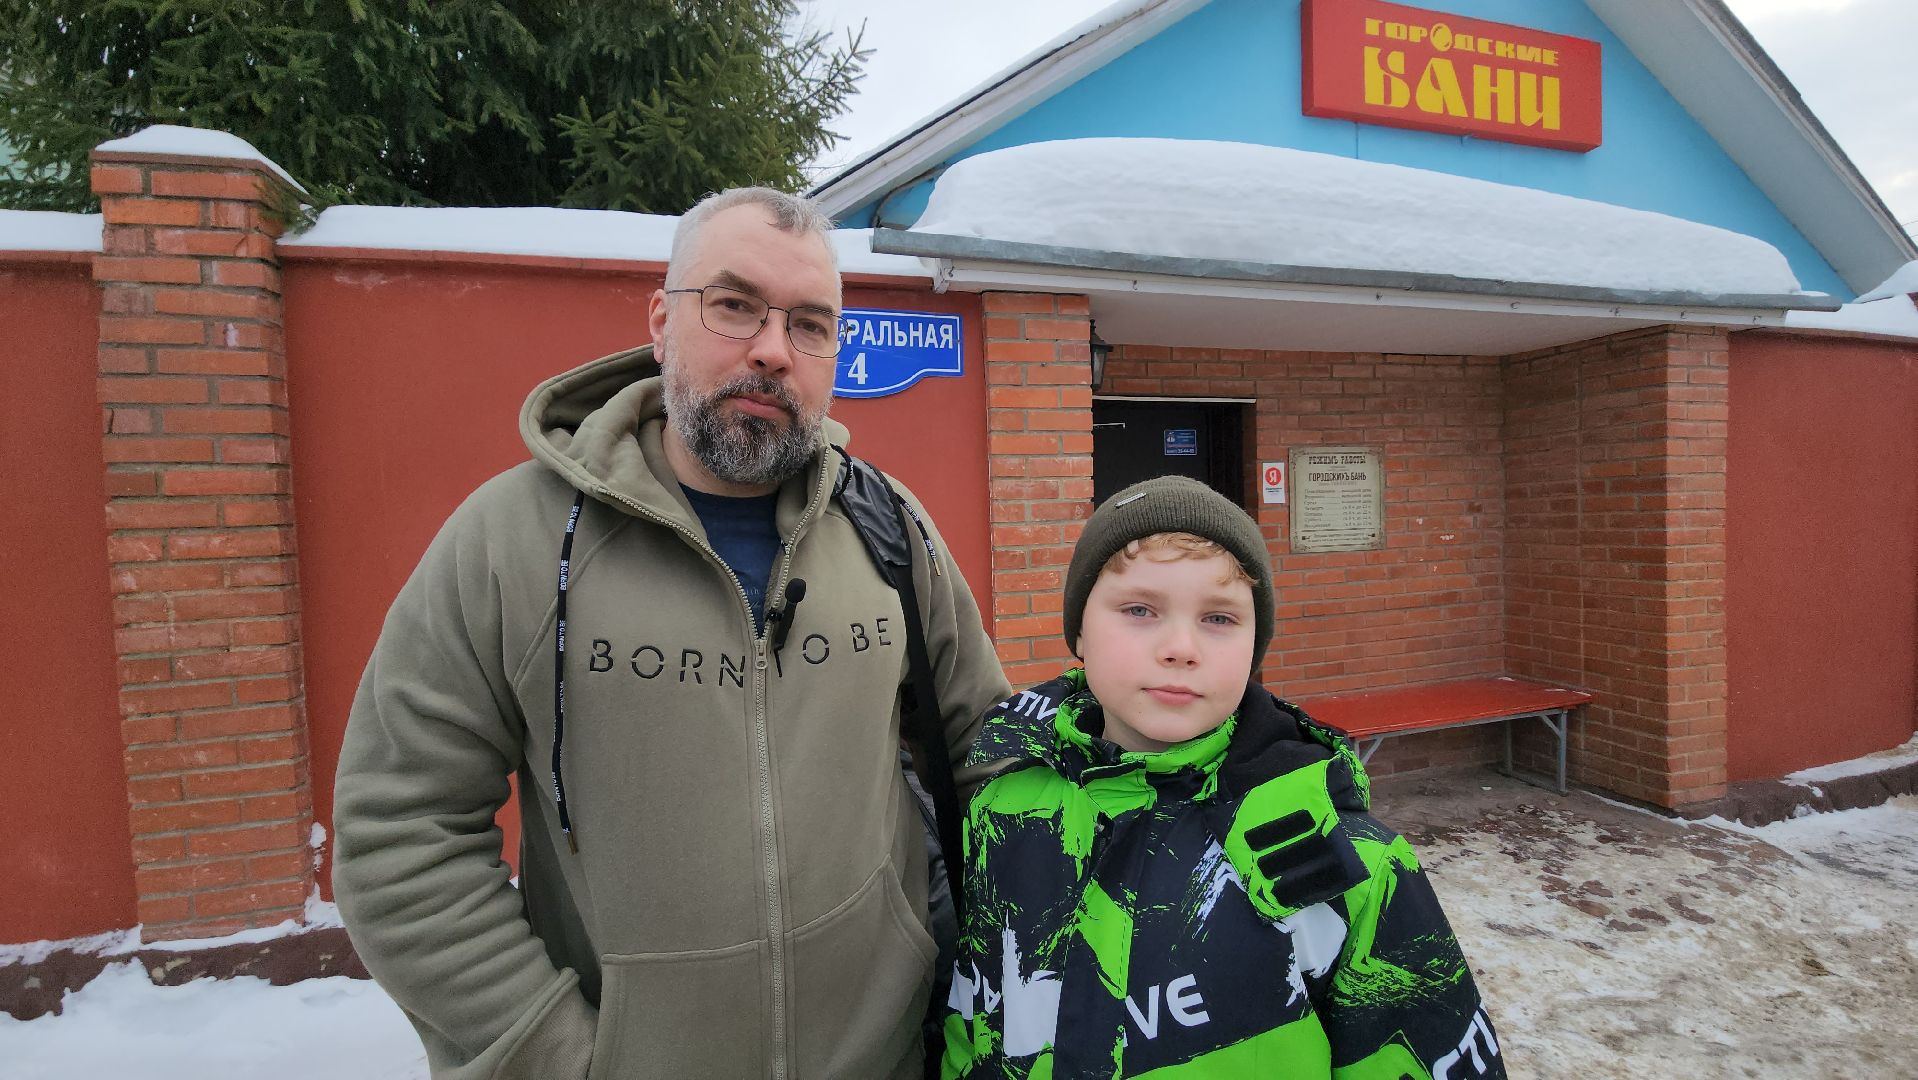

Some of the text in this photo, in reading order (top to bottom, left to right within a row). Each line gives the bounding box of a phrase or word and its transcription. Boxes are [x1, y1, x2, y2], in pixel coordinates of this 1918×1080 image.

[1365, 17, 1559, 67] ГОРОДСКИЕ
[1363, 45, 1560, 130] БАНИ
[845, 318, 954, 350] РАЛЬНАЯ
[847, 352, 869, 385] 4
[1269, 470, 1277, 483] Я
[589, 639, 746, 688] BORN
[850, 617, 891, 652] BE
[1123, 973, 1211, 1045] VE
